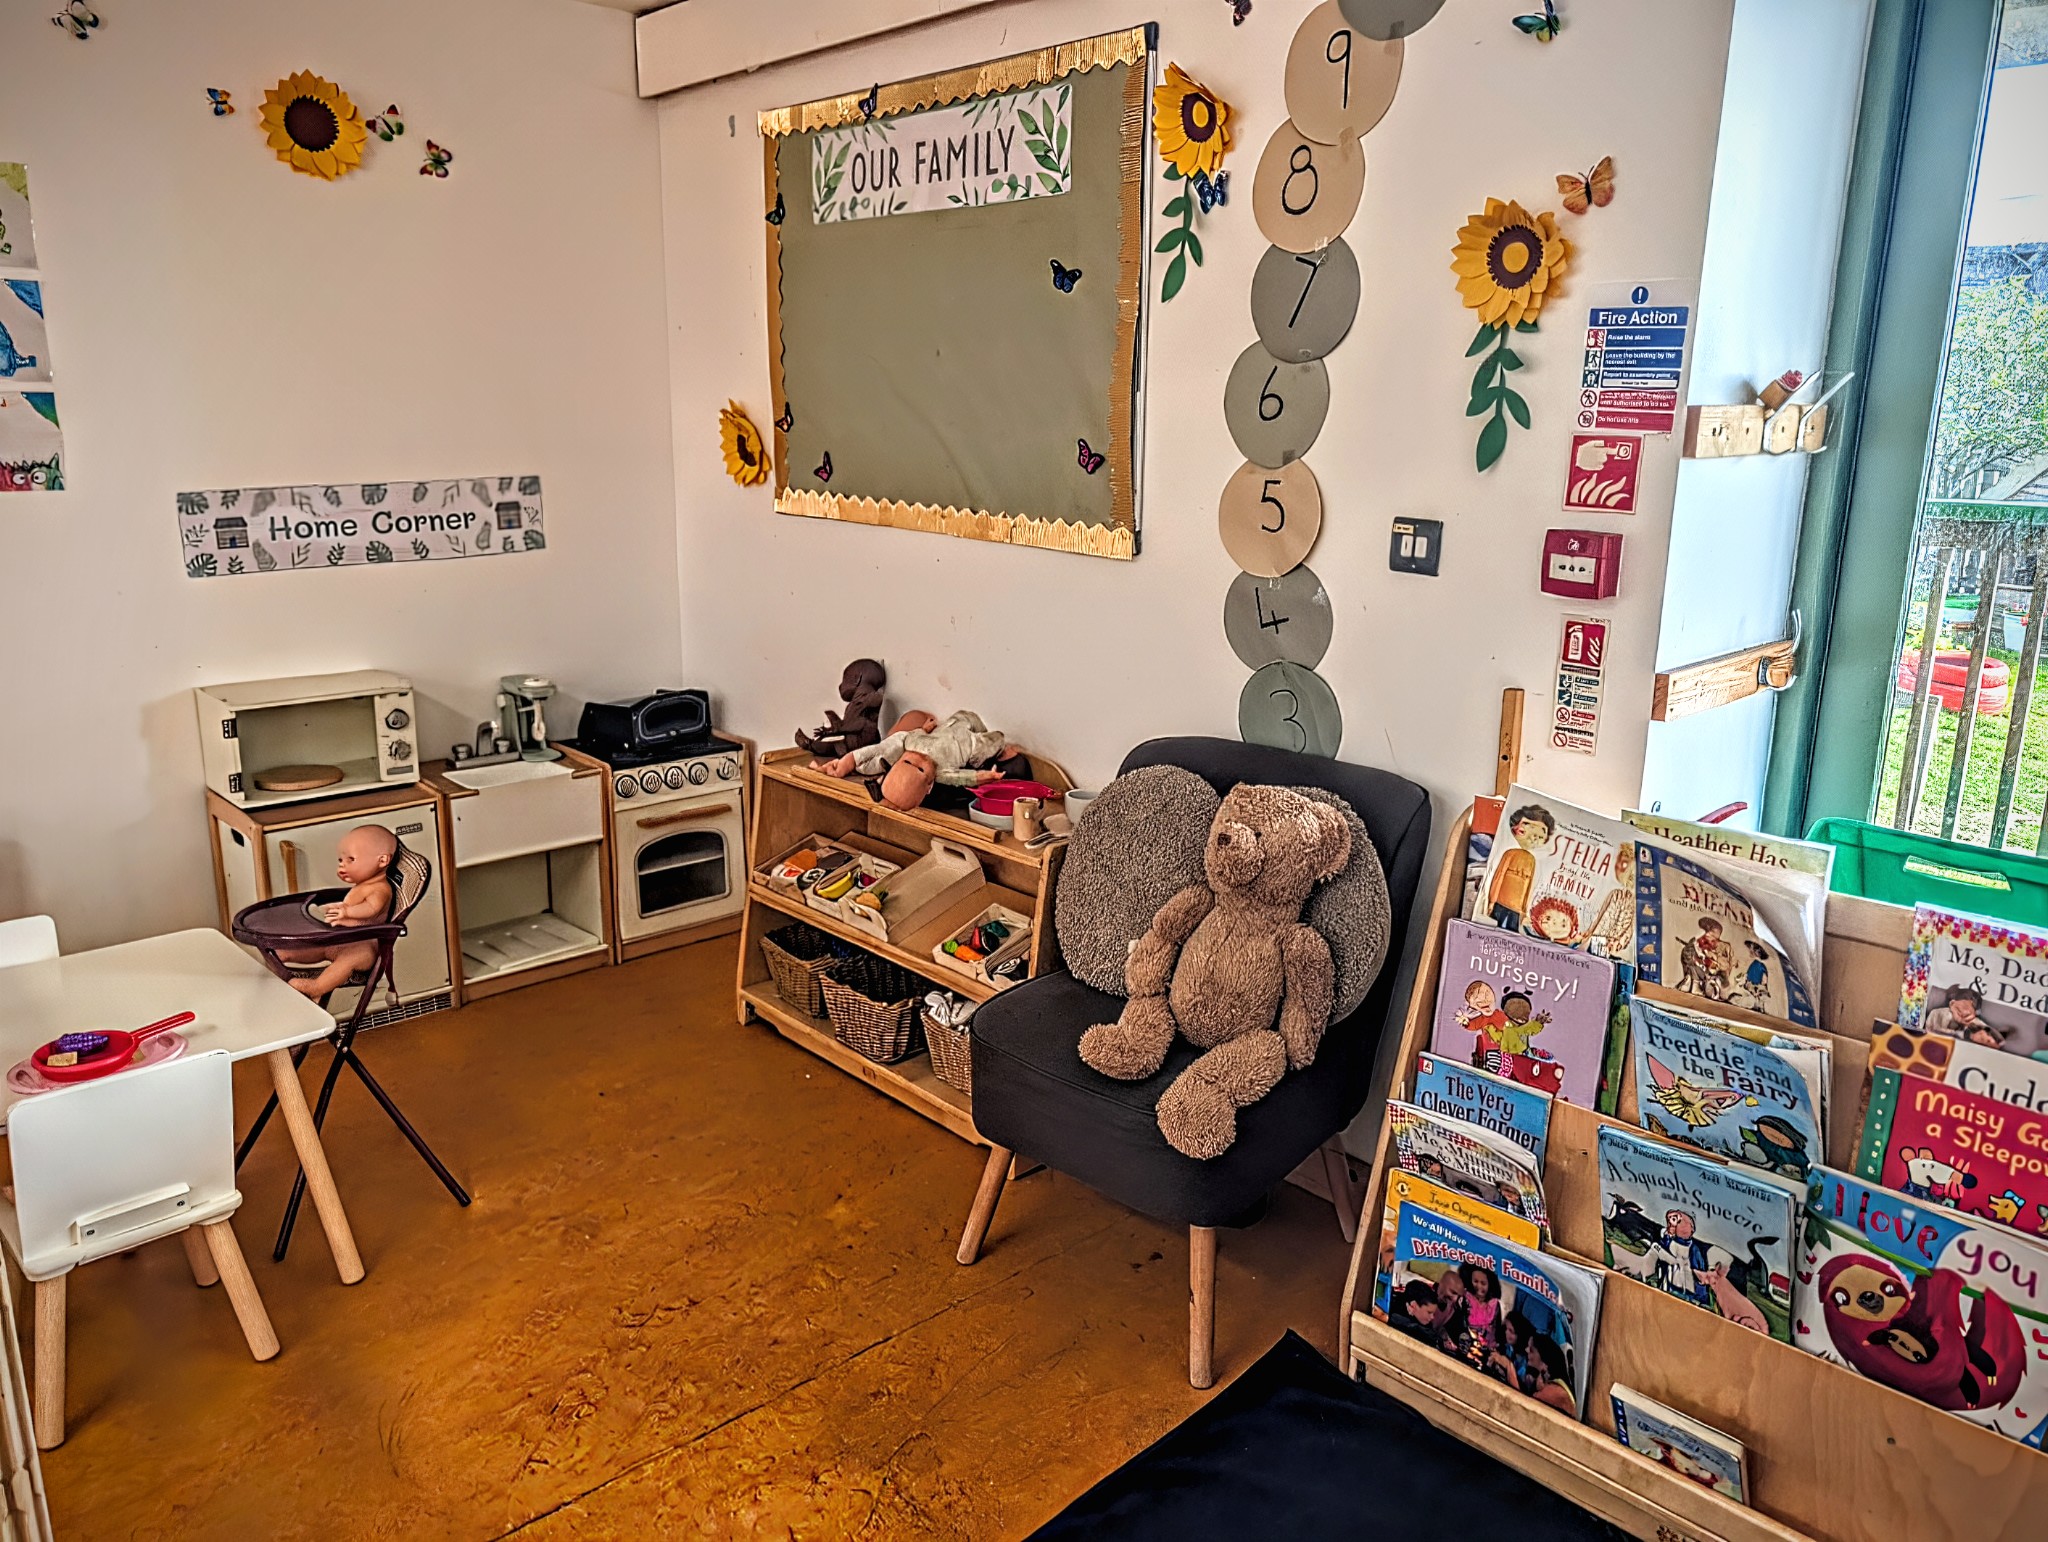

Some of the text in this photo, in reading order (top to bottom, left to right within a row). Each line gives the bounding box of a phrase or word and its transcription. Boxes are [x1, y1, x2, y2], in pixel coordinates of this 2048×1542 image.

[1326, 29, 1351, 109] 9
[851, 124, 1015, 195] OUR FAMILY
[1282, 144, 1319, 215] 8
[1288, 255, 1319, 328] 7
[1599, 310, 1678, 325] Fire Action
[1633, 352, 1657, 360] building
[1258, 365, 1284, 421] 6
[268, 510, 476, 542] Home Corner
[1261, 480, 1285, 533] 5
[1255, 587, 1290, 634] 4
[1270, 689, 1307, 753] 3
[1549, 834, 1611, 876] STELLA
[1750, 842, 1788, 868] Has
[1550, 871, 1595, 899] FAMILY
[1470, 955, 1579, 1001] nursery!
[1500, 952, 1513, 962] go
[1515, 955, 1524, 965] to
[1948, 943, 1990, 975] Me,
[1969, 976, 1987, 996] &
[1644, 1020, 1745, 1071] Freddie
[1754, 1065, 1792, 1091] and
[1445, 1076, 1515, 1121] The Very
[1682, 1056, 1799, 1110] the Fairy
[1421, 1091, 1475, 1123] Clever
[1915, 1089, 2005, 1138] Maisy
[1926, 1124, 1942, 1139] a
[1606, 1159, 1690, 1194] A Squash
[1661, 1192, 1679, 1202] and
[1412, 1214, 1467, 1246] We All Have
[1691, 1189, 1763, 1235] Squeeze
[1410, 1237, 1496, 1272] Different
[1835, 1184, 2037, 1298] I love you
